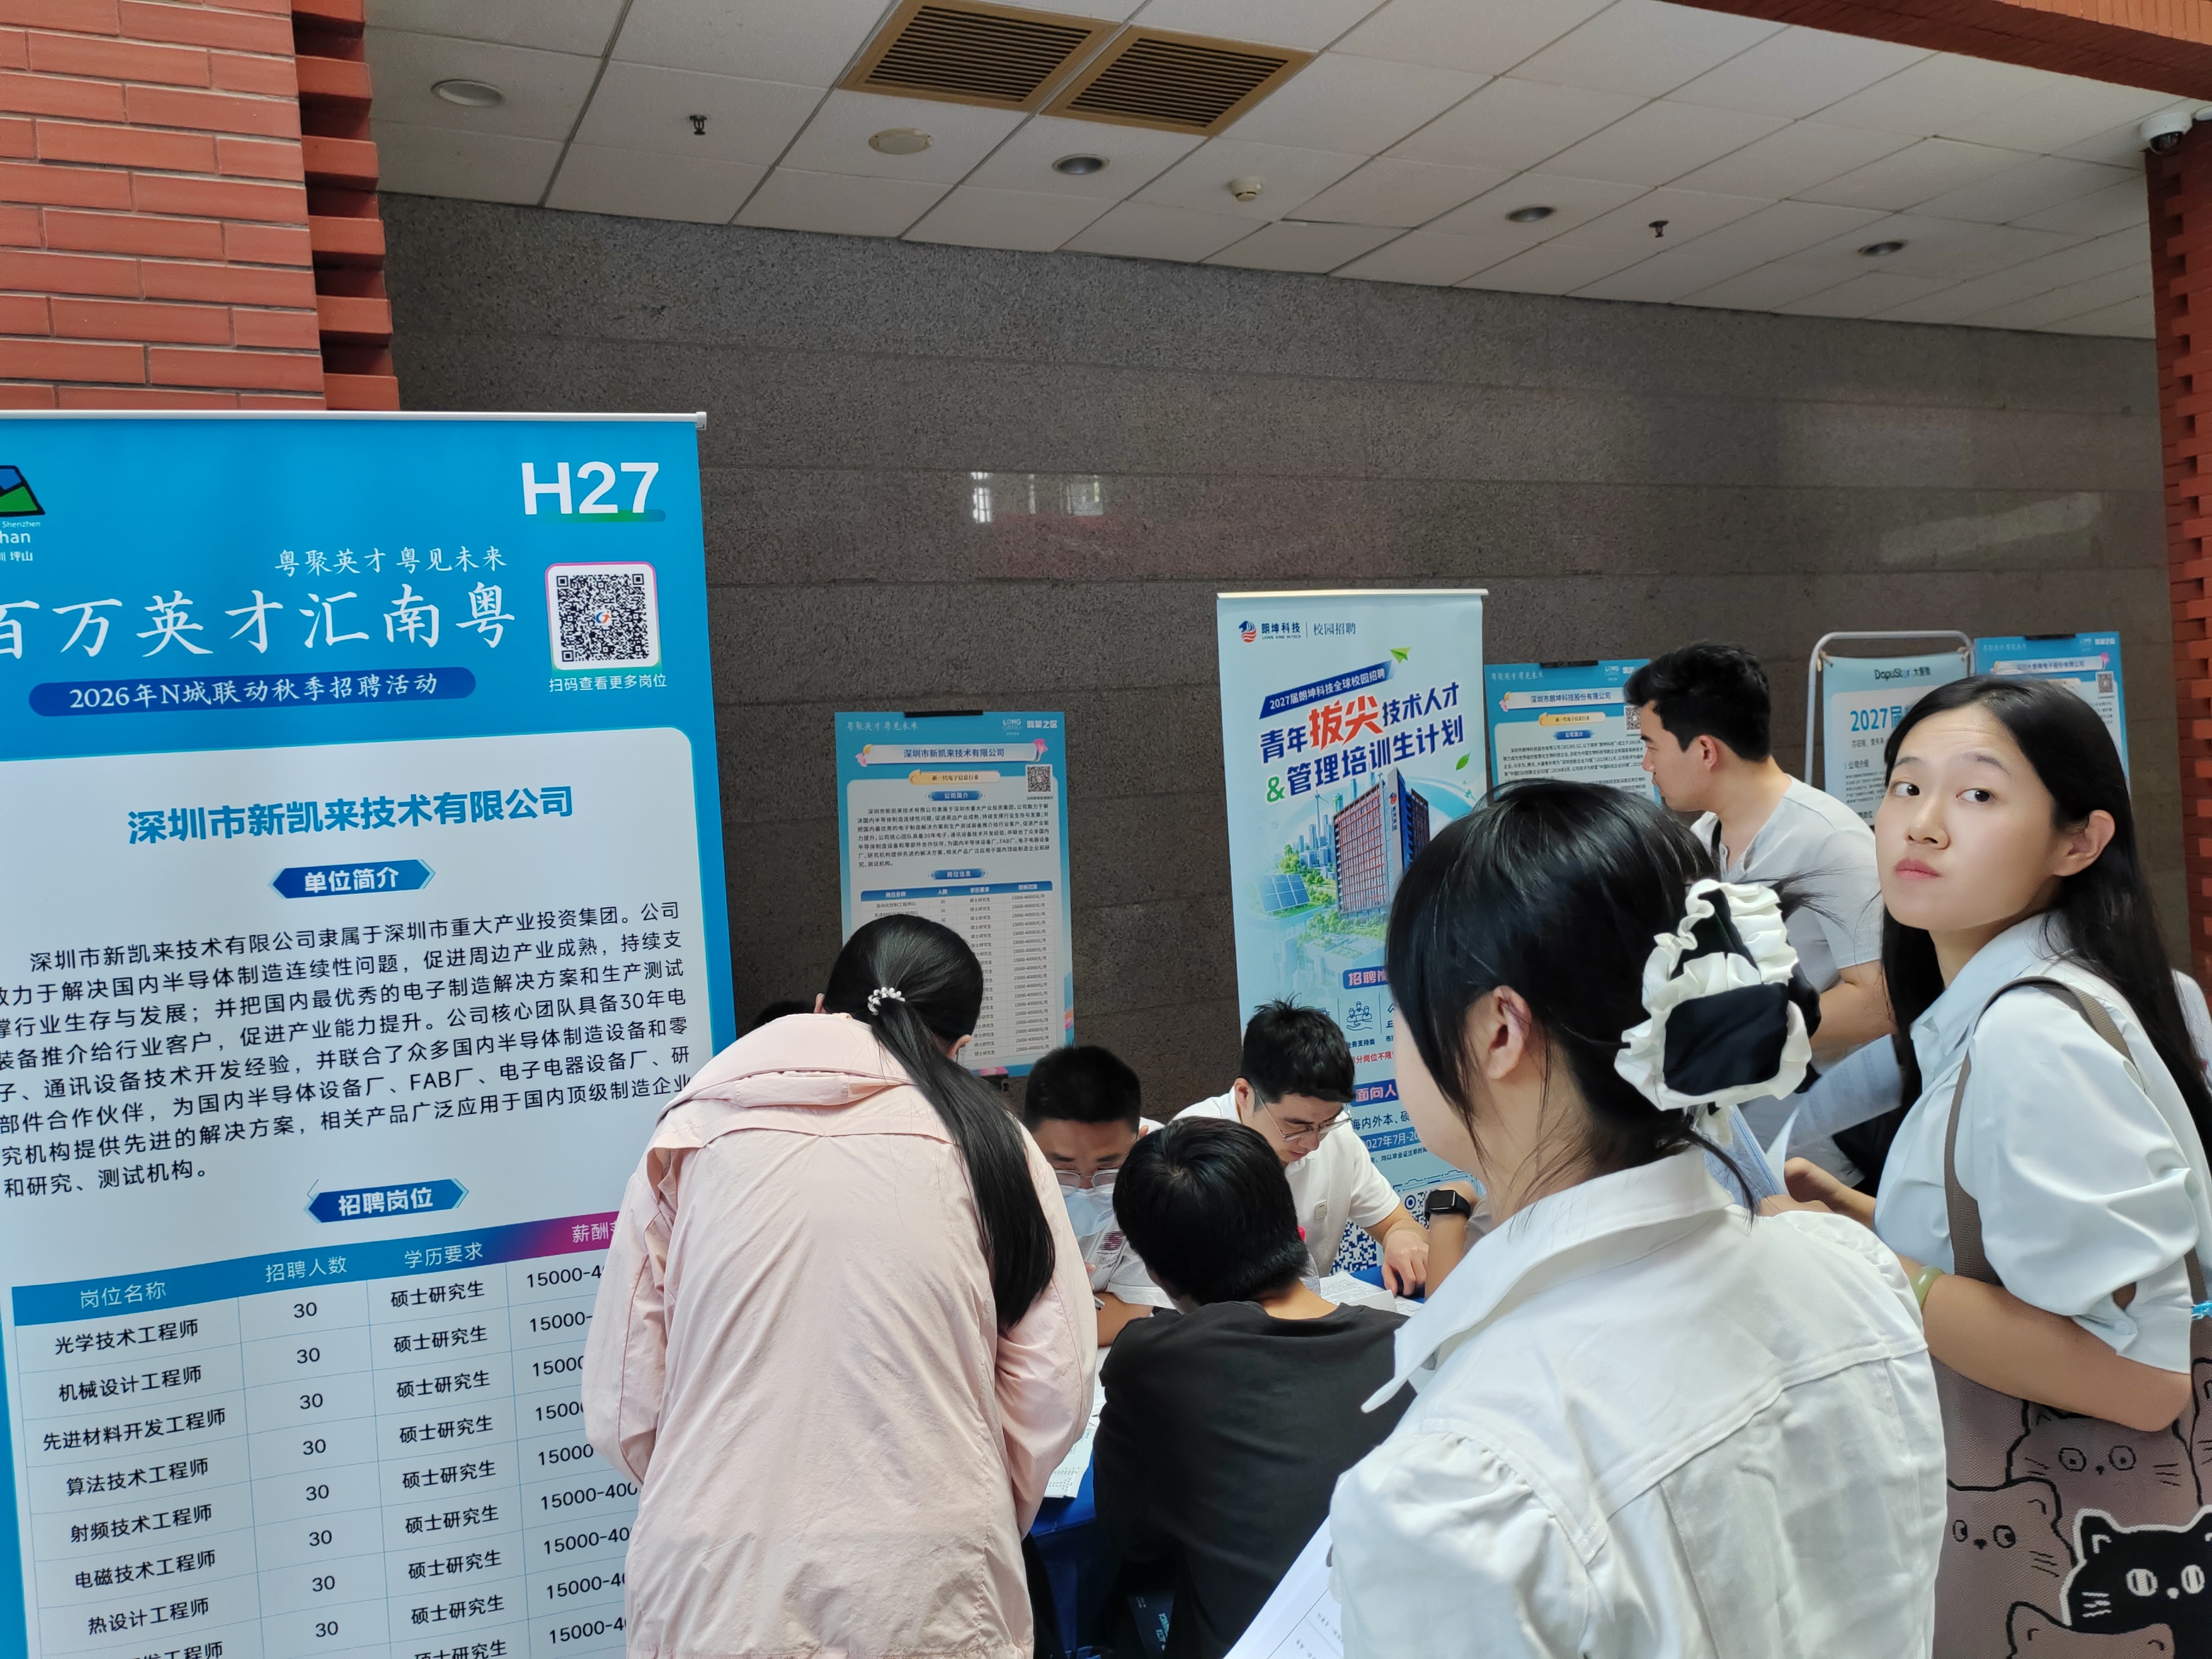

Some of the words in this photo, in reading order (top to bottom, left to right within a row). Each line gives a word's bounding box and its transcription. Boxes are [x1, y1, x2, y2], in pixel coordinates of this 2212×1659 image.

[522, 461, 659, 515] H27
[10, 551, 33, 562] 坪山
[274, 549, 387, 576] 粤聚英才
[396, 545, 508, 574] 粤见未来
[1262, 622, 1300, 634] 朗坤科技
[1313, 622, 1356, 636] 校园招聘
[69, 673, 438, 709] 2026年N城联动秋季招聘活动
[549, 673, 667, 692] 扫码查看更多岗位
[1270, 668, 1385, 710] 2027届朗坤科技全球校园招聘
[1530, 692, 1611, 703] 深圳市朗坤科技股份有限公司
[1260, 681, 1460, 764] 青年拔尖技术人才
[1850, 705, 1914, 731] 2027届
[903, 748, 1004, 758] 深圳市新凯来技术有限公司
[128, 785, 574, 845] 深圳市新凯来技术有限公司
[304, 867, 400, 894] 单位简介
[29, 901, 679, 973] 深圳市新凯来技术有限公司隶属于深圳市重大产业投资集团。公司
[1363, 1131, 1419, 1149] 027年7月-20
[4, 1158, 207, 1198] 和研究、测试机构。
[338, 1188, 434, 1216] 招聘岗位
[79, 1280, 167, 1309] 岗位名称
[265, 1256, 347, 1282] 招聘人数
[404, 1241, 483, 1268] 学历要求
[55, 1318, 199, 1356] 光学技术工程师
[293, 1301, 318, 1319] 30
[390, 1279, 485, 1309] 硕士研究生
[58, 1364, 203, 1402] 机械设计工程师
[296, 1347, 321, 1364] 30
[393, 1325, 488, 1355] 硕士研究生
[43, 1407, 226, 1452] 先进材料开发工程师
[299, 1392, 324, 1410] 30
[396, 1369, 491, 1400] 硕士研究生
[66, 1458, 210, 1497] 算法技术工程师
[302, 1438, 327, 1455] 30
[399, 1414, 494, 1446] 硕士研究生
[70, 1503, 213, 1543] 射频技术工程师
[306, 1484, 330, 1501] 30
[402, 1460, 497, 1491] 硕士研究生
[75, 1549, 216, 1589] 电磁技术工程师
[309, 1529, 333, 1547] 30
[405, 1505, 500, 1536] 硕士研究生
[87, 1597, 209, 1635] 热设计工程师
[312, 1576, 336, 1592] 30
[408, 1549, 502, 1580] 硕士研究生
[543, 1526, 633, 1555] 15000-40
[315, 1621, 339, 1637] 30
[411, 1594, 505, 1625] 硕士研究生
